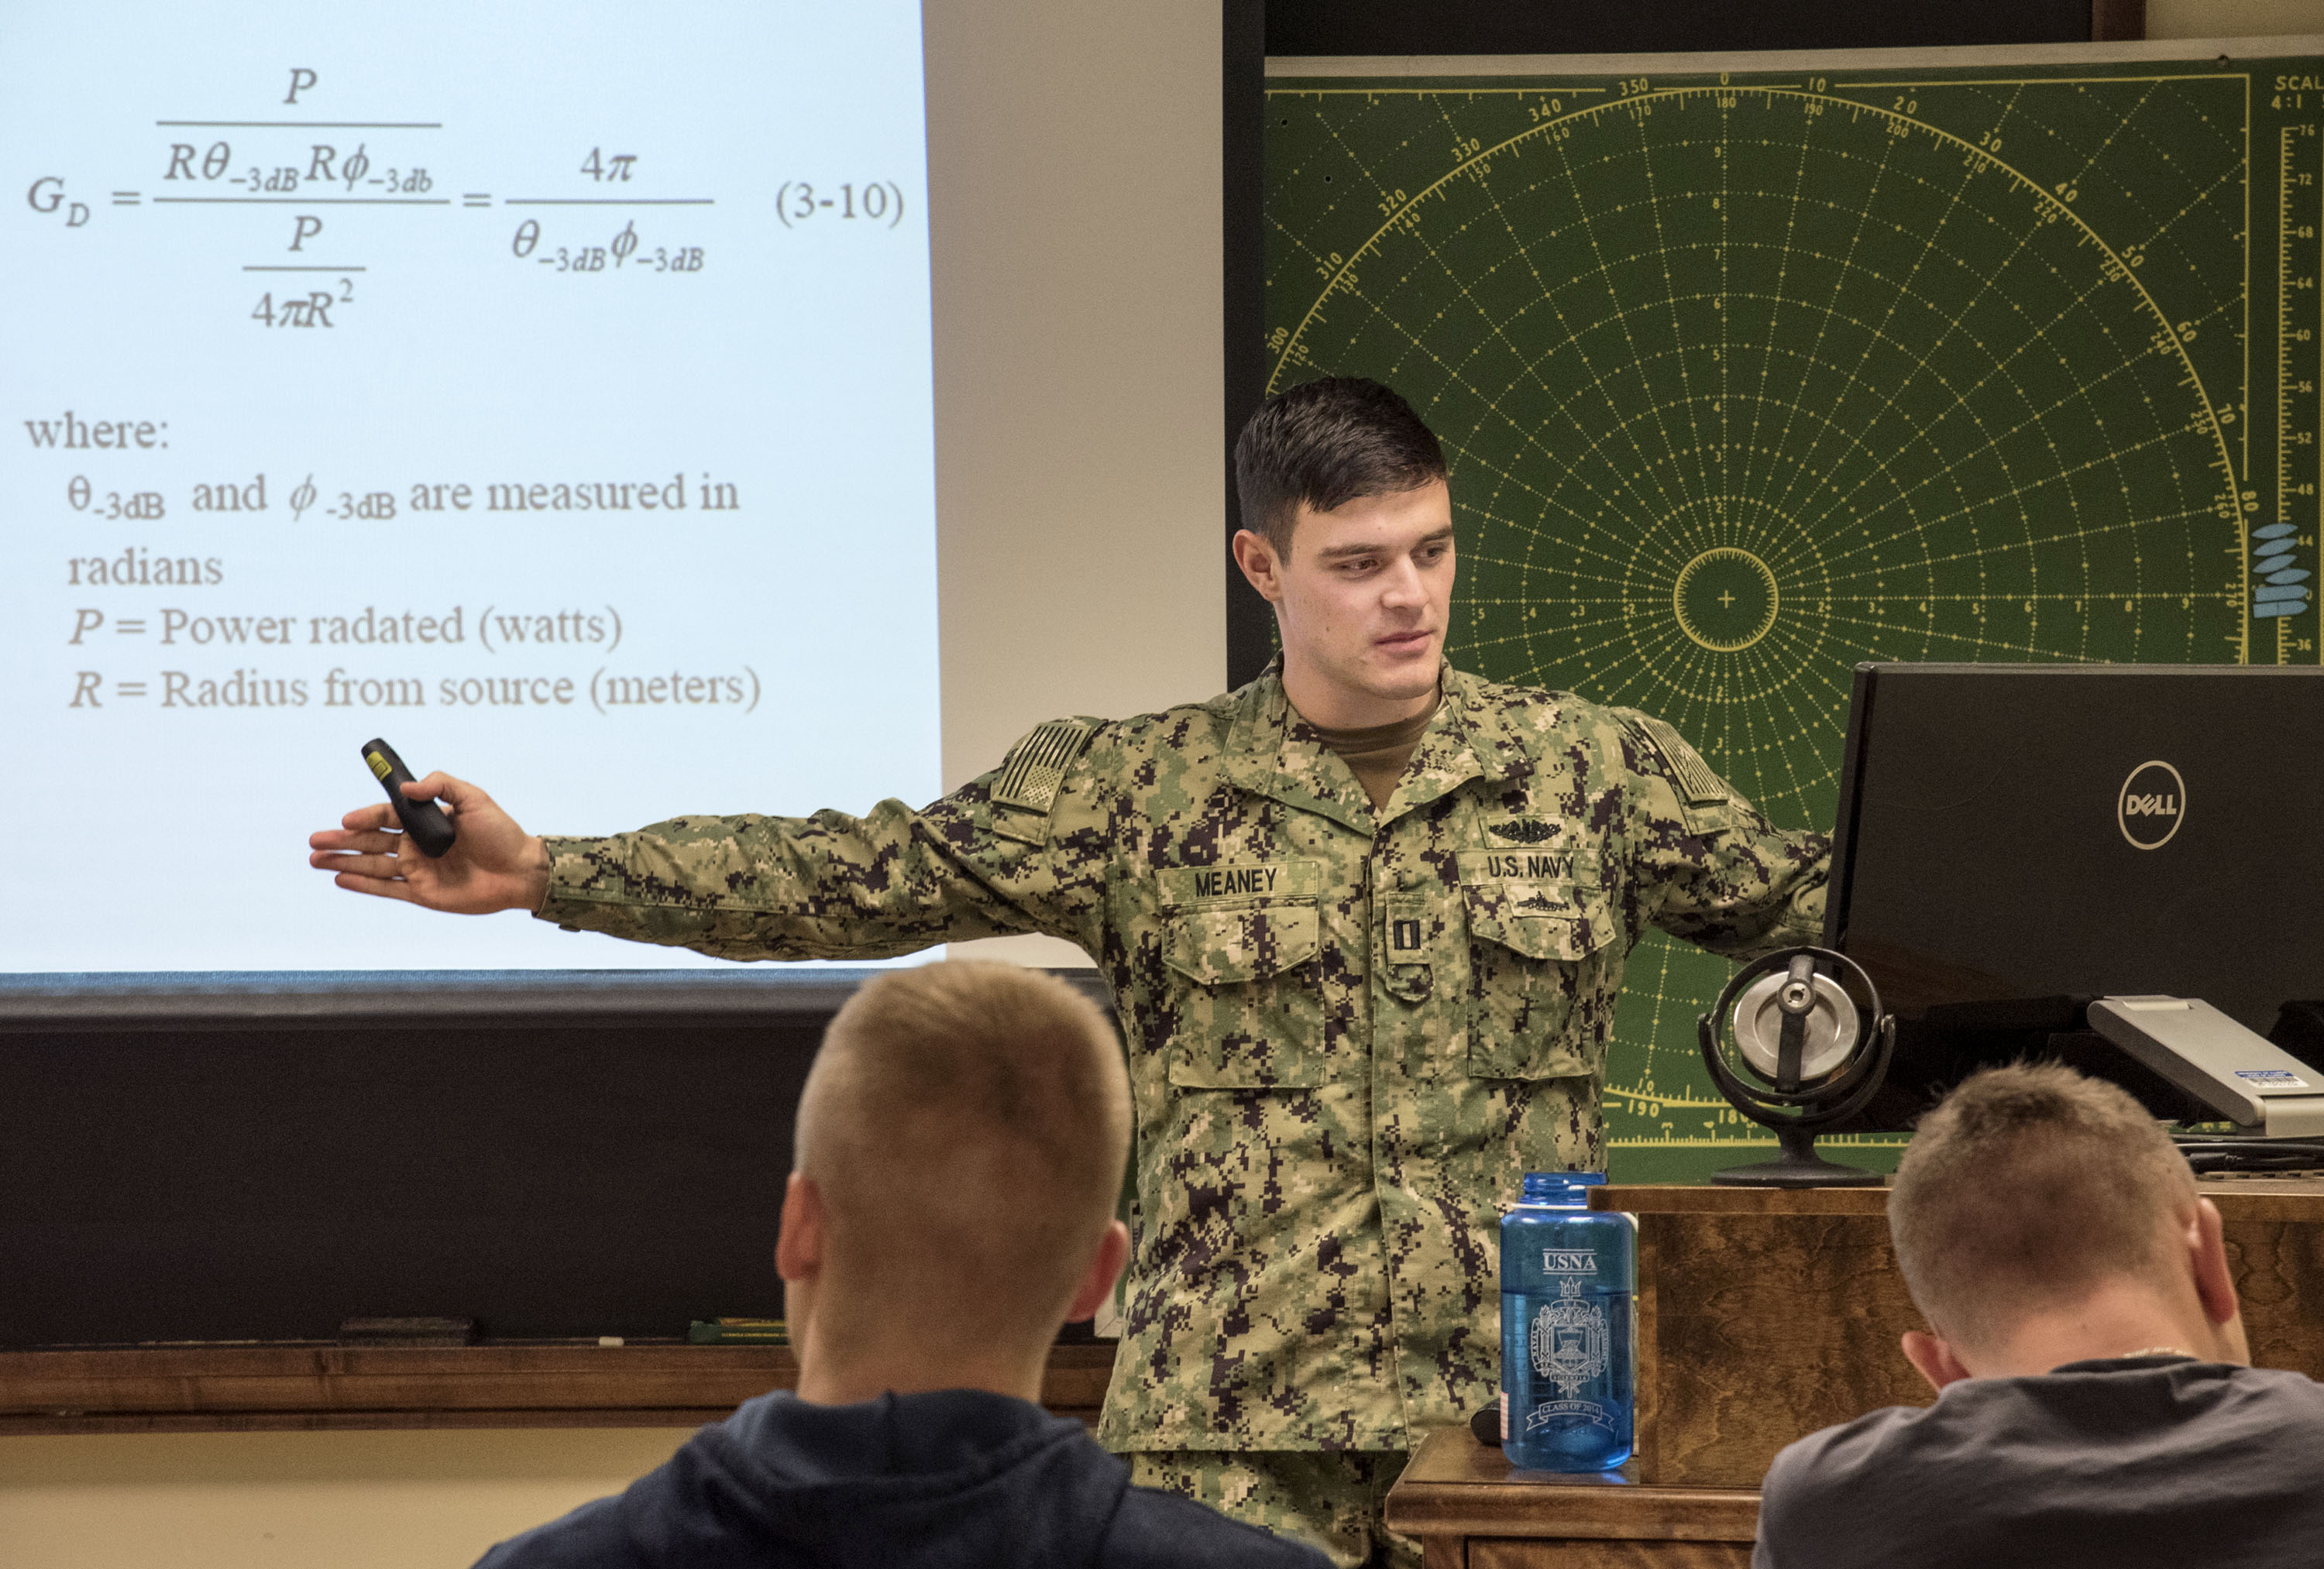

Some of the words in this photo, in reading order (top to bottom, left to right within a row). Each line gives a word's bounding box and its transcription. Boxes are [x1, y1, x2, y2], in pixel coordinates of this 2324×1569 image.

[283, 68, 317, 104] P
[2298, 173, 2312, 186] 72
[776, 180, 904, 228] (3-10)
[287, 215, 322, 251] P
[2298, 225, 2314, 239] 68
[2297, 276, 2313, 289] 64
[25, 411, 168, 448] where:
[2297, 431, 2312, 445] 52
[192, 473, 268, 511] and
[410, 482, 472, 511] are
[486, 472, 687, 511] measured
[700, 472, 740, 510] in
[68, 548, 223, 585] radians
[68, 609, 104, 644] P
[160, 609, 296, 644] Power
[309, 606, 465, 644] radated
[480, 606, 622, 653] (watts)
[69, 671, 102, 708] R
[160, 668, 310, 707] Radius
[324, 668, 425, 707] from
[439, 675, 574, 706] source
[591, 667, 761, 715] (meters)
[2126, 793, 2177, 816] DELL
[1487, 857, 1522, 877] U.S.
[1528, 856, 1573, 878] NAVY
[1195, 868, 1277, 897] MEANEY
[1628, 1099, 1659, 1118] 190
[1543, 1253, 1597, 1270] USNA
